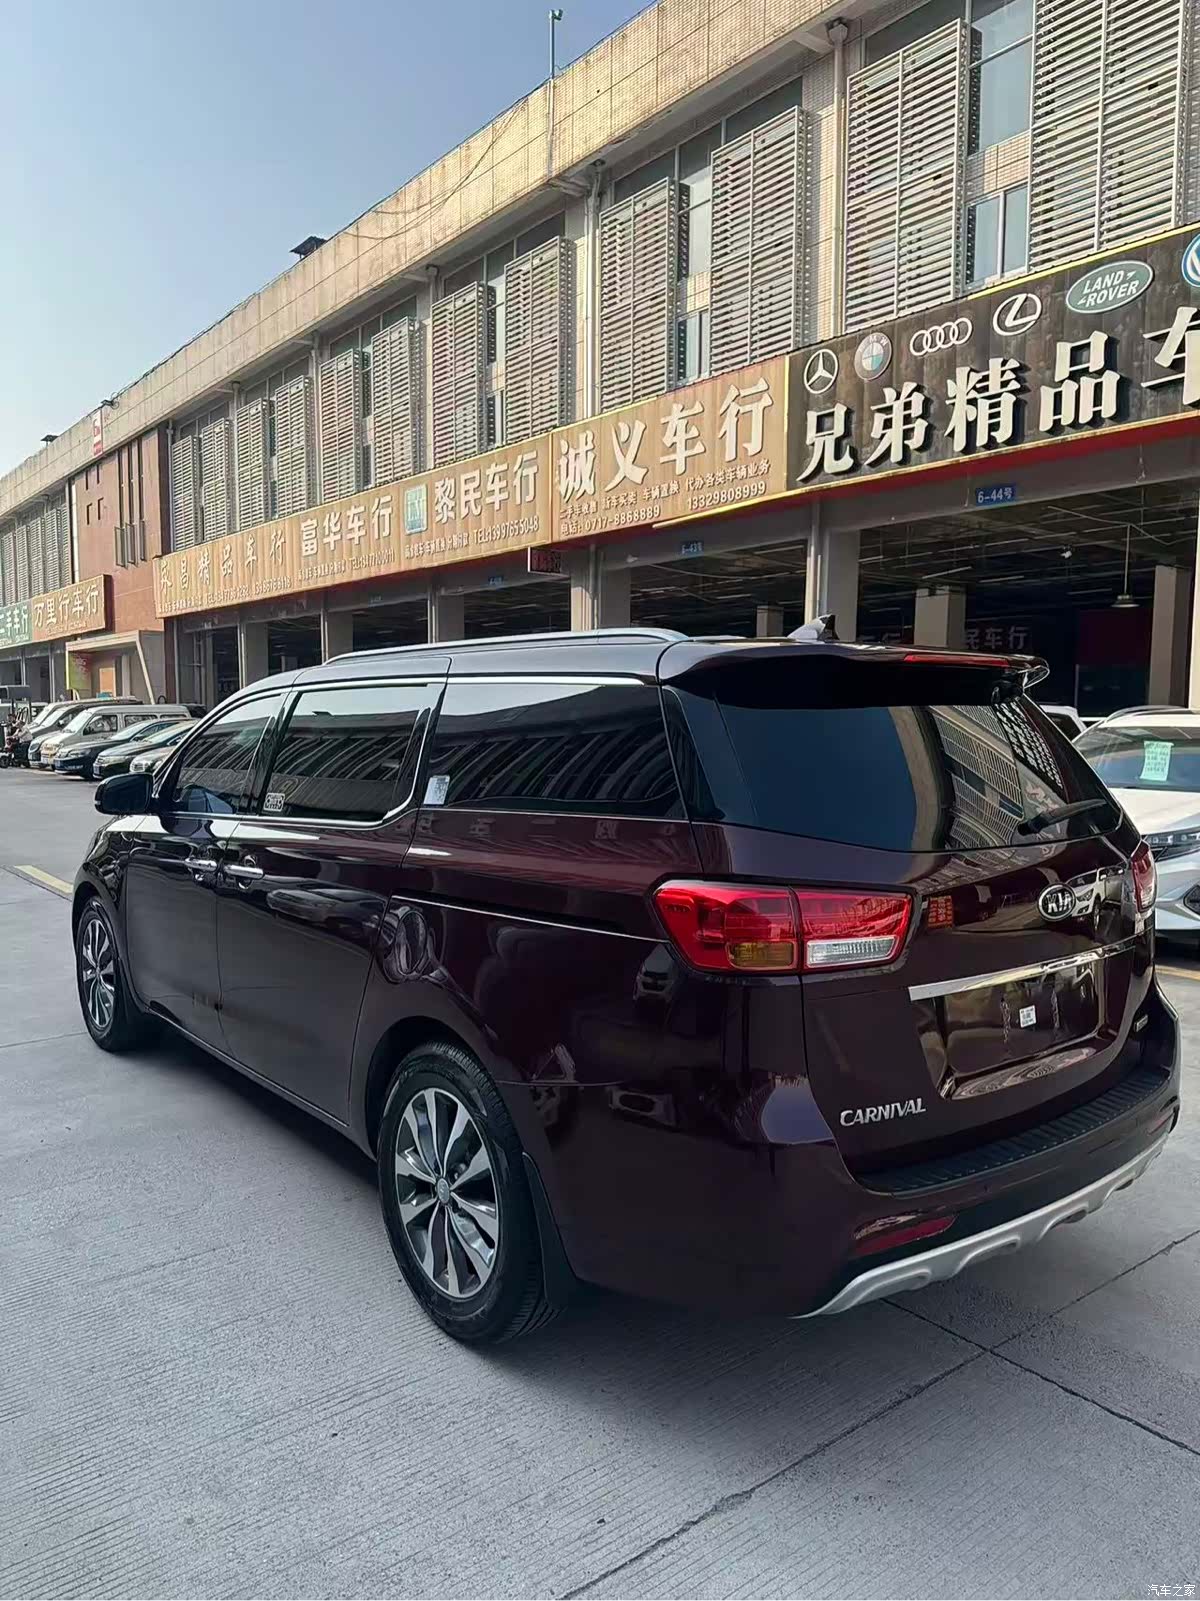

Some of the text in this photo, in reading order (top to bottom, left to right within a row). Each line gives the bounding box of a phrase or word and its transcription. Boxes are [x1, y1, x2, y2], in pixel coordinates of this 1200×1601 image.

[1083, 270, 1124, 294] LAND
[1085, 280, 1140, 307] ROVER
[558, 377, 774, 503] 诚义车行
[434, 450, 540, 525] 黎民车行
[687, 480, 767, 511] 13329808999
[977, 487, 1013, 504] 6-44号
[301, 495, 393, 557] 富华车行
[1045, 891, 1072, 913] KIA
[840, 1097, 927, 1127] CARNIVAL
